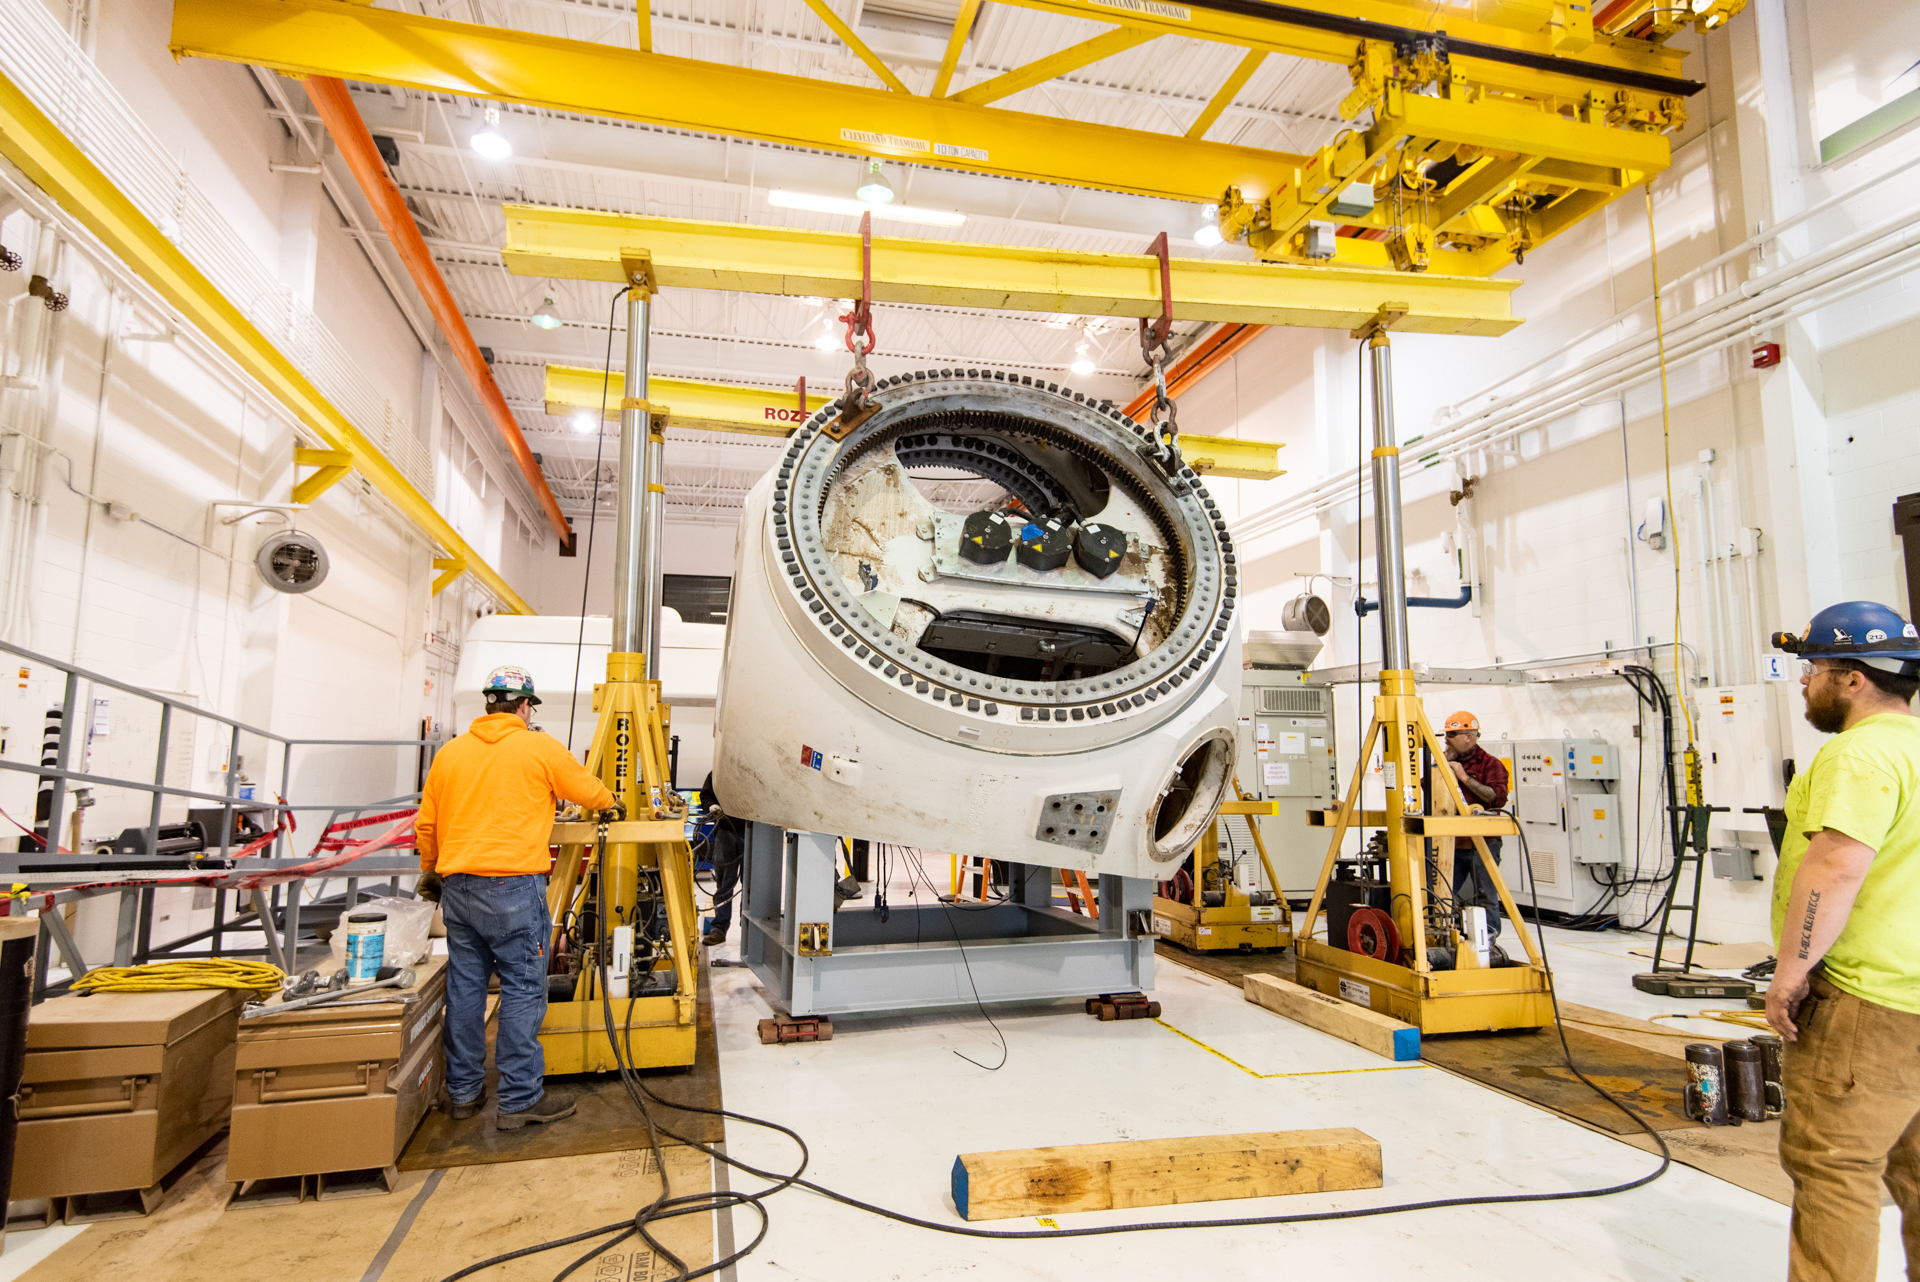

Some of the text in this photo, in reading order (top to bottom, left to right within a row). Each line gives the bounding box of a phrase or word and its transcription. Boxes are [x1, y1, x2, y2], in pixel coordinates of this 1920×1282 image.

[1091, 0, 1188, 20] EVELAND TRAMRAIL
[843, 129, 928, 151] CLEVELAND TRAMRAIL
[937, 144, 988, 161] 10 TON CAPACITY
[616, 718, 629, 799] ROZEL
[1803, 889, 1821, 932] REDNECK
[633, 1251, 650, 1282] RAM BO
